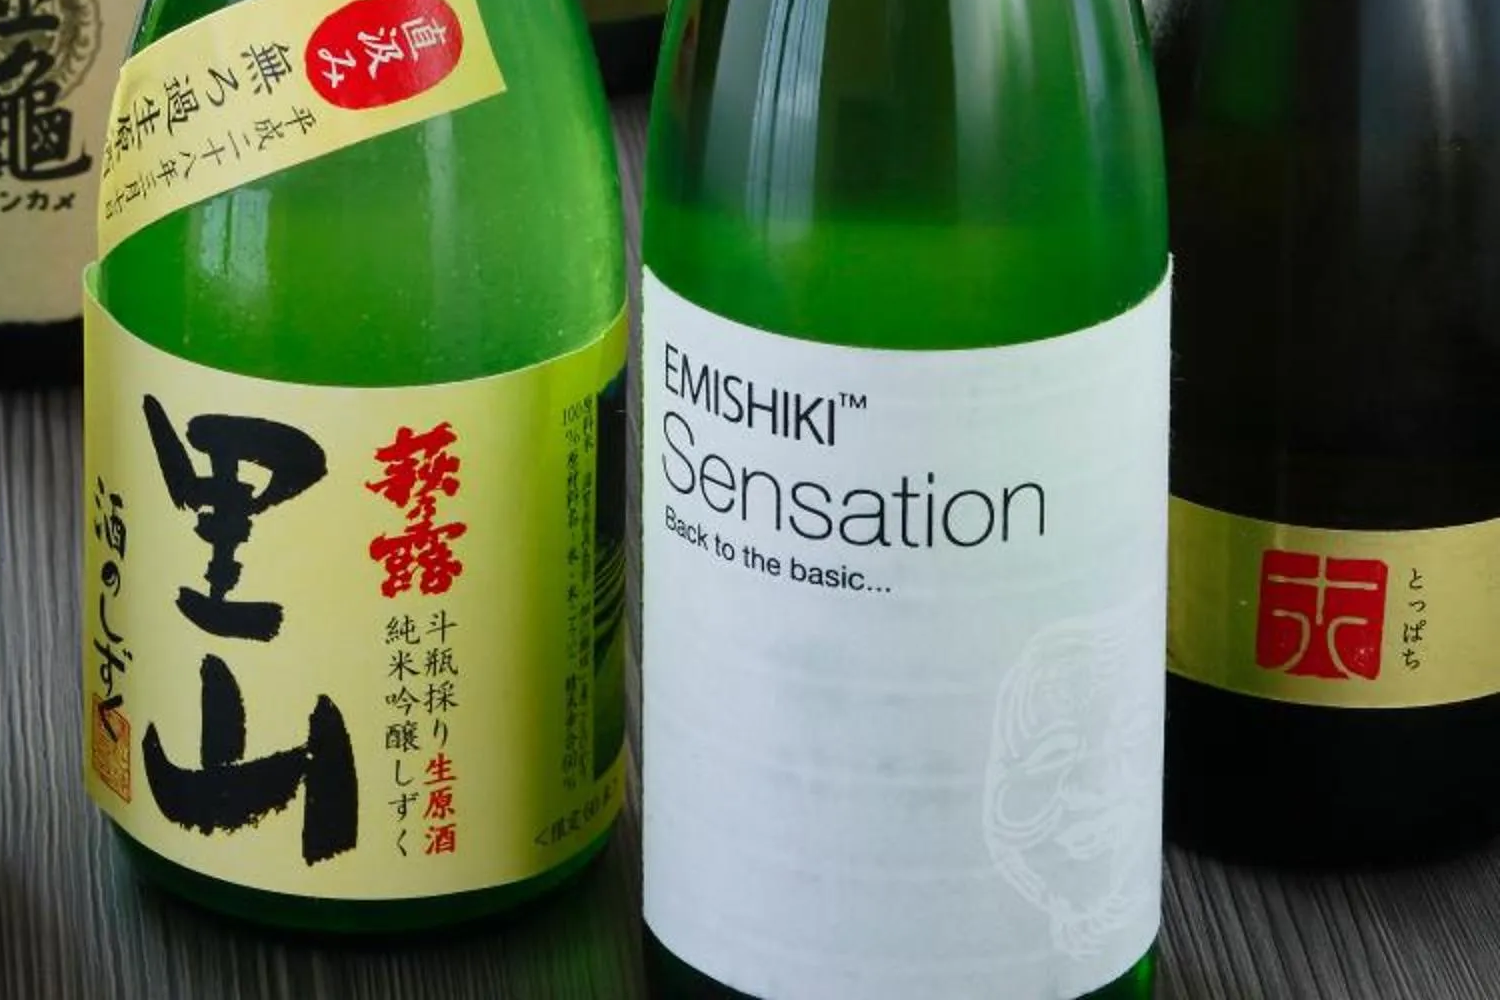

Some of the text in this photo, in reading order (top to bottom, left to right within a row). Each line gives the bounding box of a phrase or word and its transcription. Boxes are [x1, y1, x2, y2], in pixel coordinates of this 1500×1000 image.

[315, 14, 450, 89] 直汲み
[661, 410, 1046, 549] Sensation
[664, 503, 892, 594] Back to the basic...
[142, 393, 359, 867] 里山
[1401, 566, 1428, 671] とっぱち
[384, 614, 422, 859] 純米吟醸しずく
